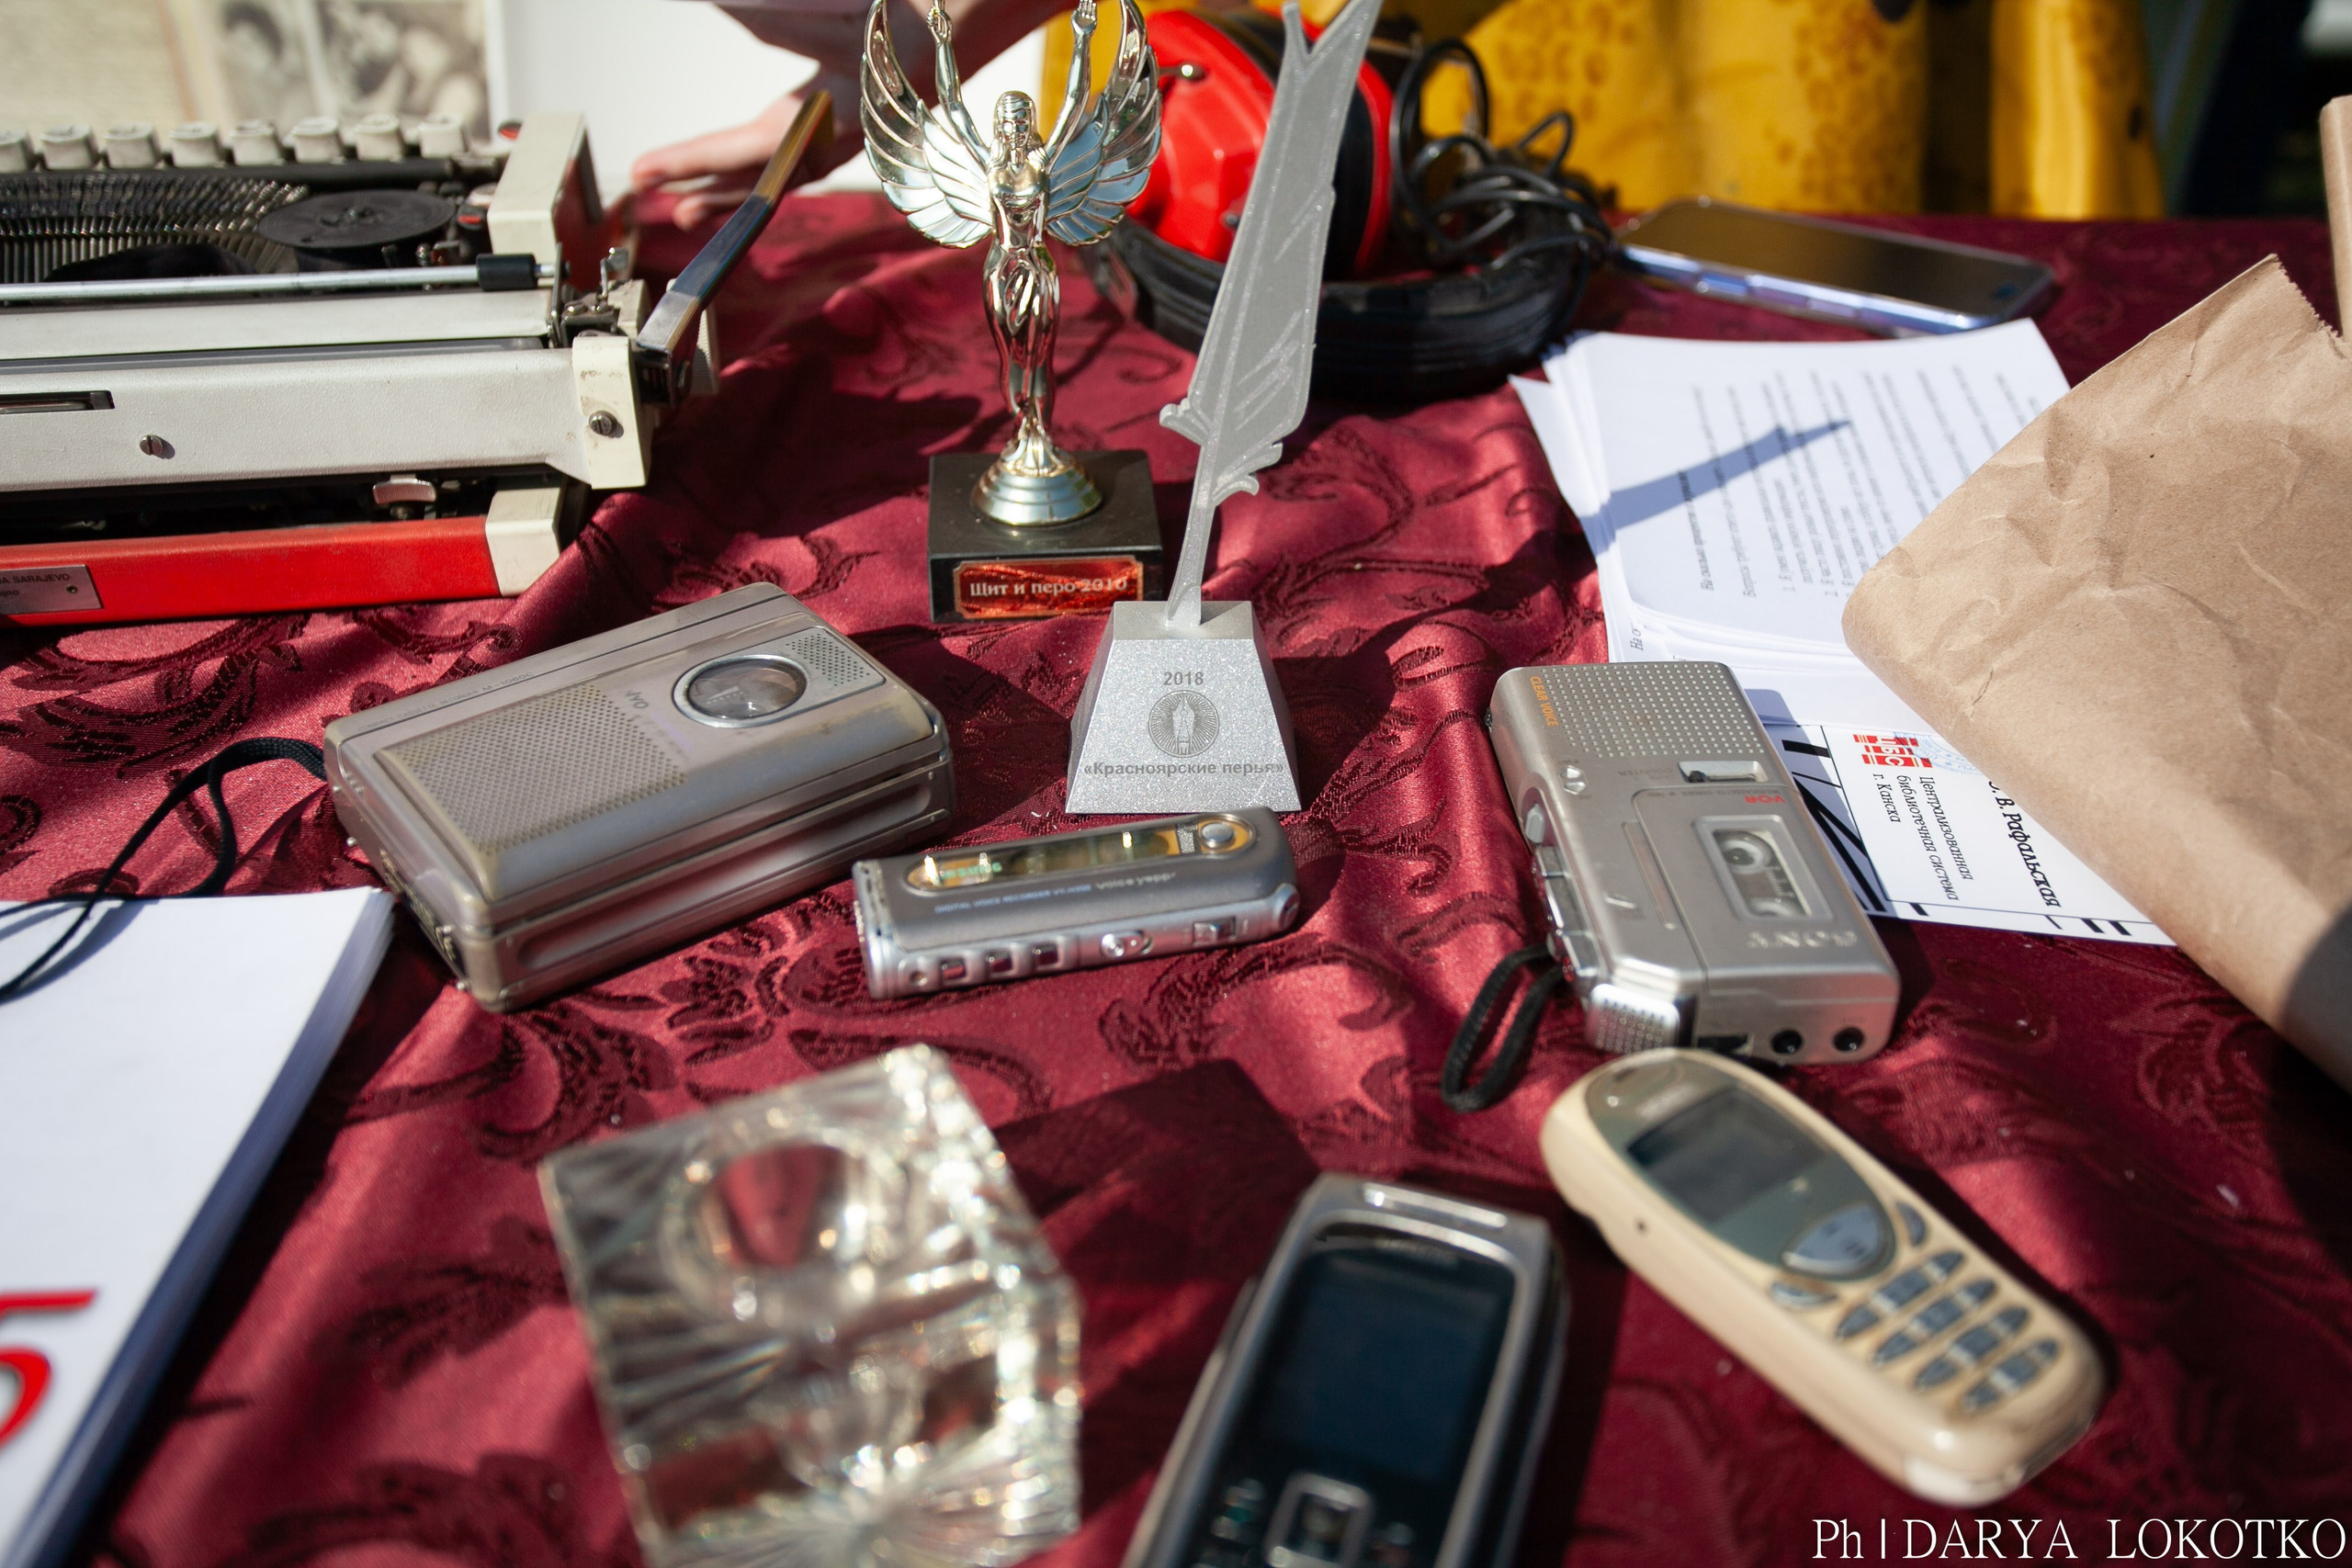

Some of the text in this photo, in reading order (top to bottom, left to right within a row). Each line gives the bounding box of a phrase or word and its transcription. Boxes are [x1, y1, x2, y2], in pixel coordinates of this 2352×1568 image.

[13, 573, 70, 583] SARAJEVO
[970, 582, 1009, 597] Щит
[1013, 583, 1025, 595] и
[1163, 671, 1204, 686] 2018
[1530, 676, 1559, 727] CLEAR VOICE
[1876, 736, 1905, 767] ЦБС
[1084, 761, 1284, 778] «Красноярские перья»
[1872, 773, 1902, 824] г. Канска
[1995, 795, 2016, 810] В.
[1896, 773, 1960, 902] библиотечная система
[1919, 775, 1974, 882] Централизованная
[2004, 812, 2062, 908] Рафальская
[974, 897, 1001, 908] VOICE
[1002, 890, 1051, 905] RECORDER
[1747, 930, 1858, 948] SONY
